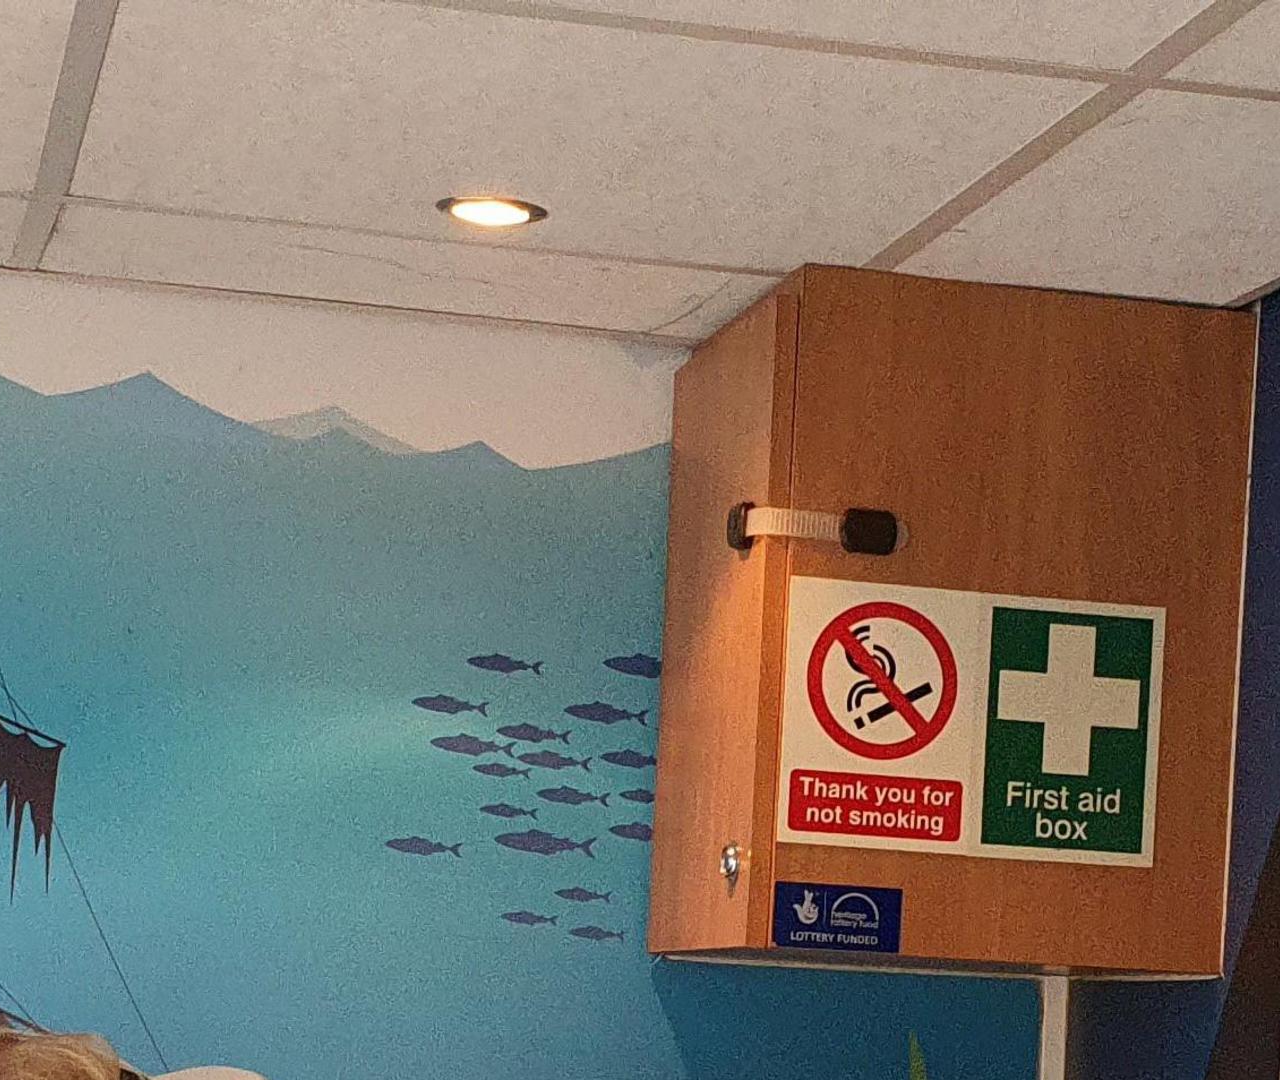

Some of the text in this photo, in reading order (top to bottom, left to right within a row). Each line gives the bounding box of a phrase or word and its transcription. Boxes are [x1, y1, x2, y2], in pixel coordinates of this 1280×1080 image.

[798, 776, 954, 807] Thank you for
[1005, 781, 1120, 814] First aid
[805, 804, 944, 836] not smoking
[1034, 813, 1088, 840] box
[790, 931, 878, 945] LOTTERY FUNDED
